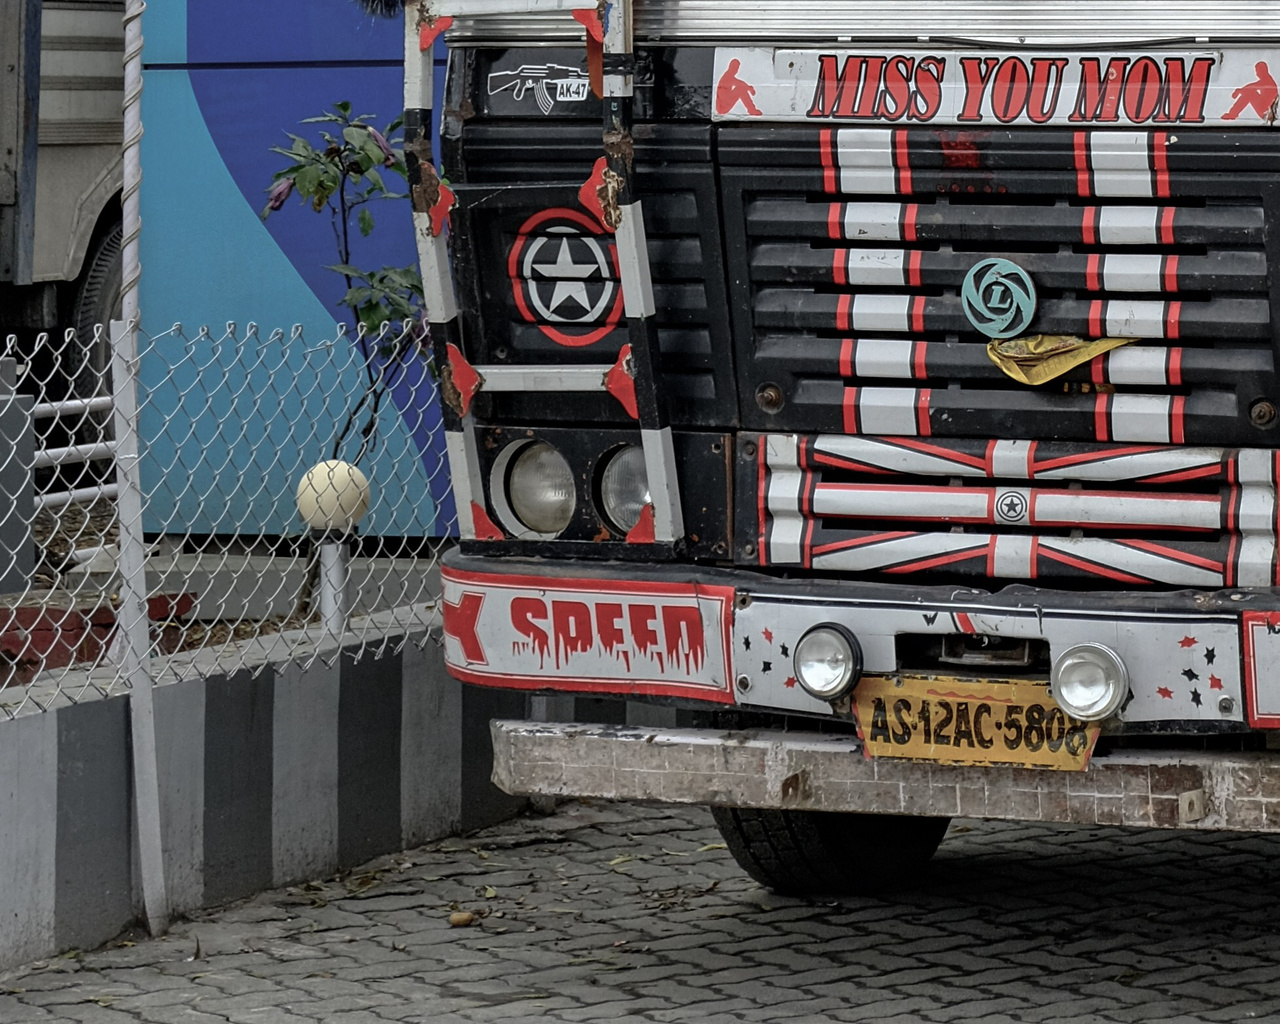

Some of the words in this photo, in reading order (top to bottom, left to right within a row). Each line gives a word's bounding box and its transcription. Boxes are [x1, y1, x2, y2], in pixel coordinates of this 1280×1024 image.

[558, 82, 587, 98] AK-47
[806, 53, 945, 122] MISS
[955, 56, 1071, 123] YOU
[1073, 56, 1218, 124] MOM
[509, 596, 705, 676] SPEED
